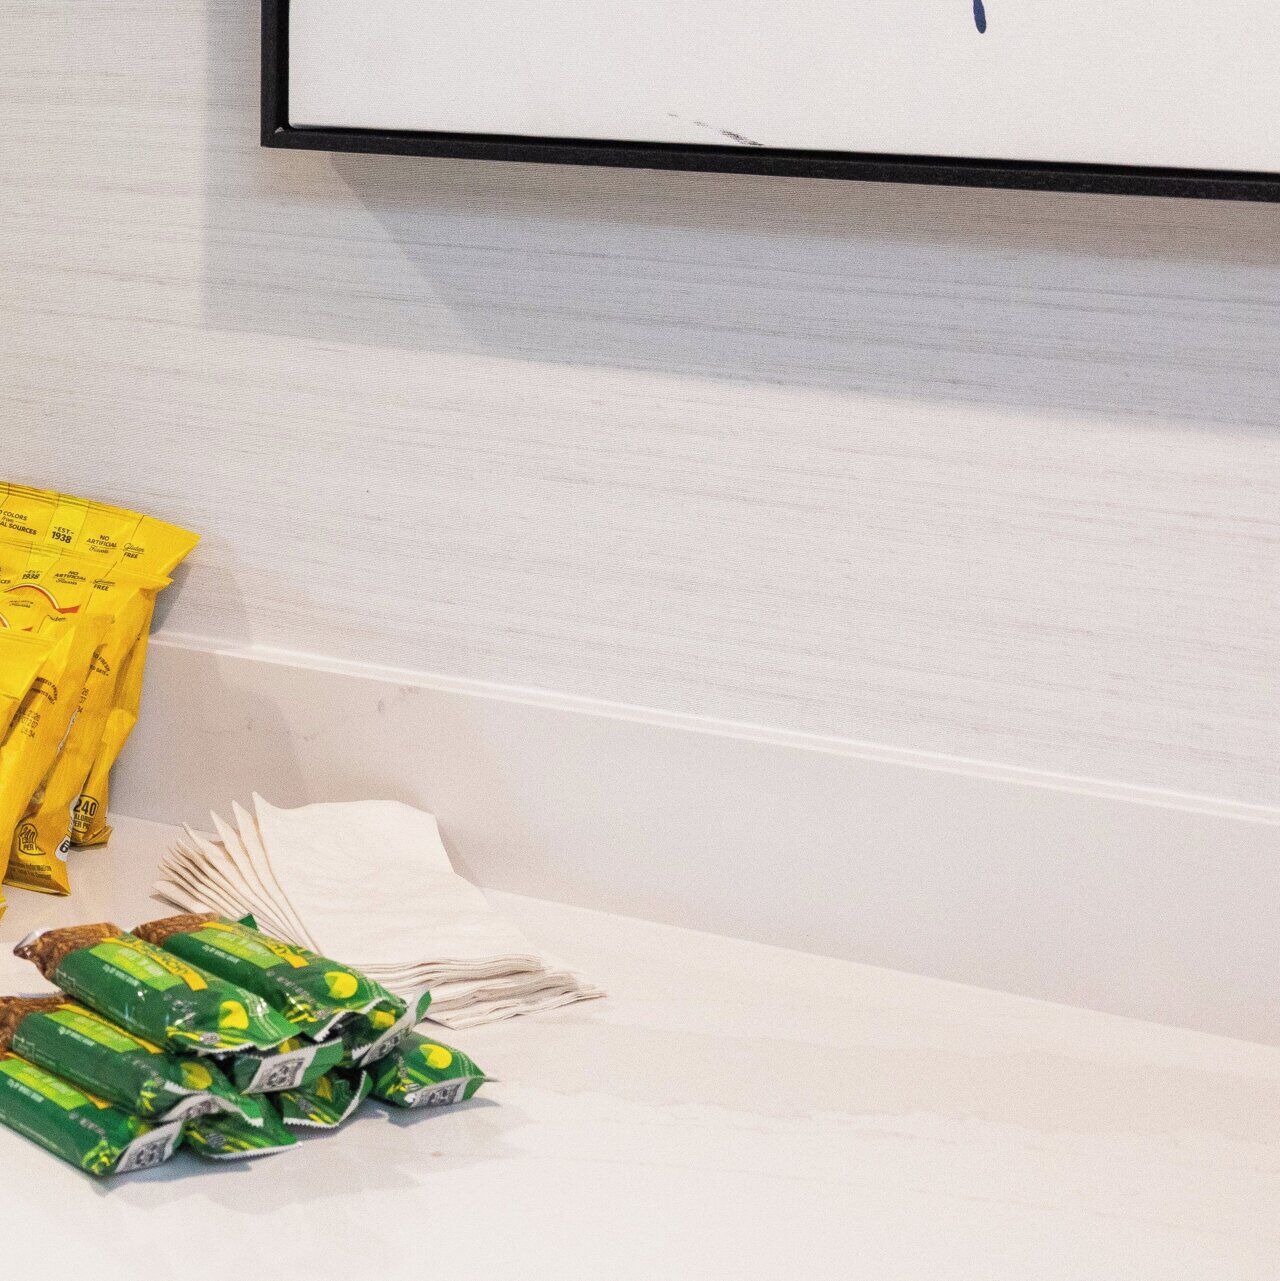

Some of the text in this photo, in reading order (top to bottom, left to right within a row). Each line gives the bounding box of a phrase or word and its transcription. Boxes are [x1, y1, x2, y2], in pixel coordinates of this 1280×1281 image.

[5, 509, 28, 521] COLORS
[8, 523, 38, 536] SOURCES
[51, 531, 73, 544] 1938
[86, 537, 118, 549] ARTIFICIAL
[100, 534, 110, 542] NO
[123, 551, 139, 559] FREE
[22, 572, 41, 580] 1938
[93, 583, 110, 591] FREE
[73, 799, 97, 816] 240
